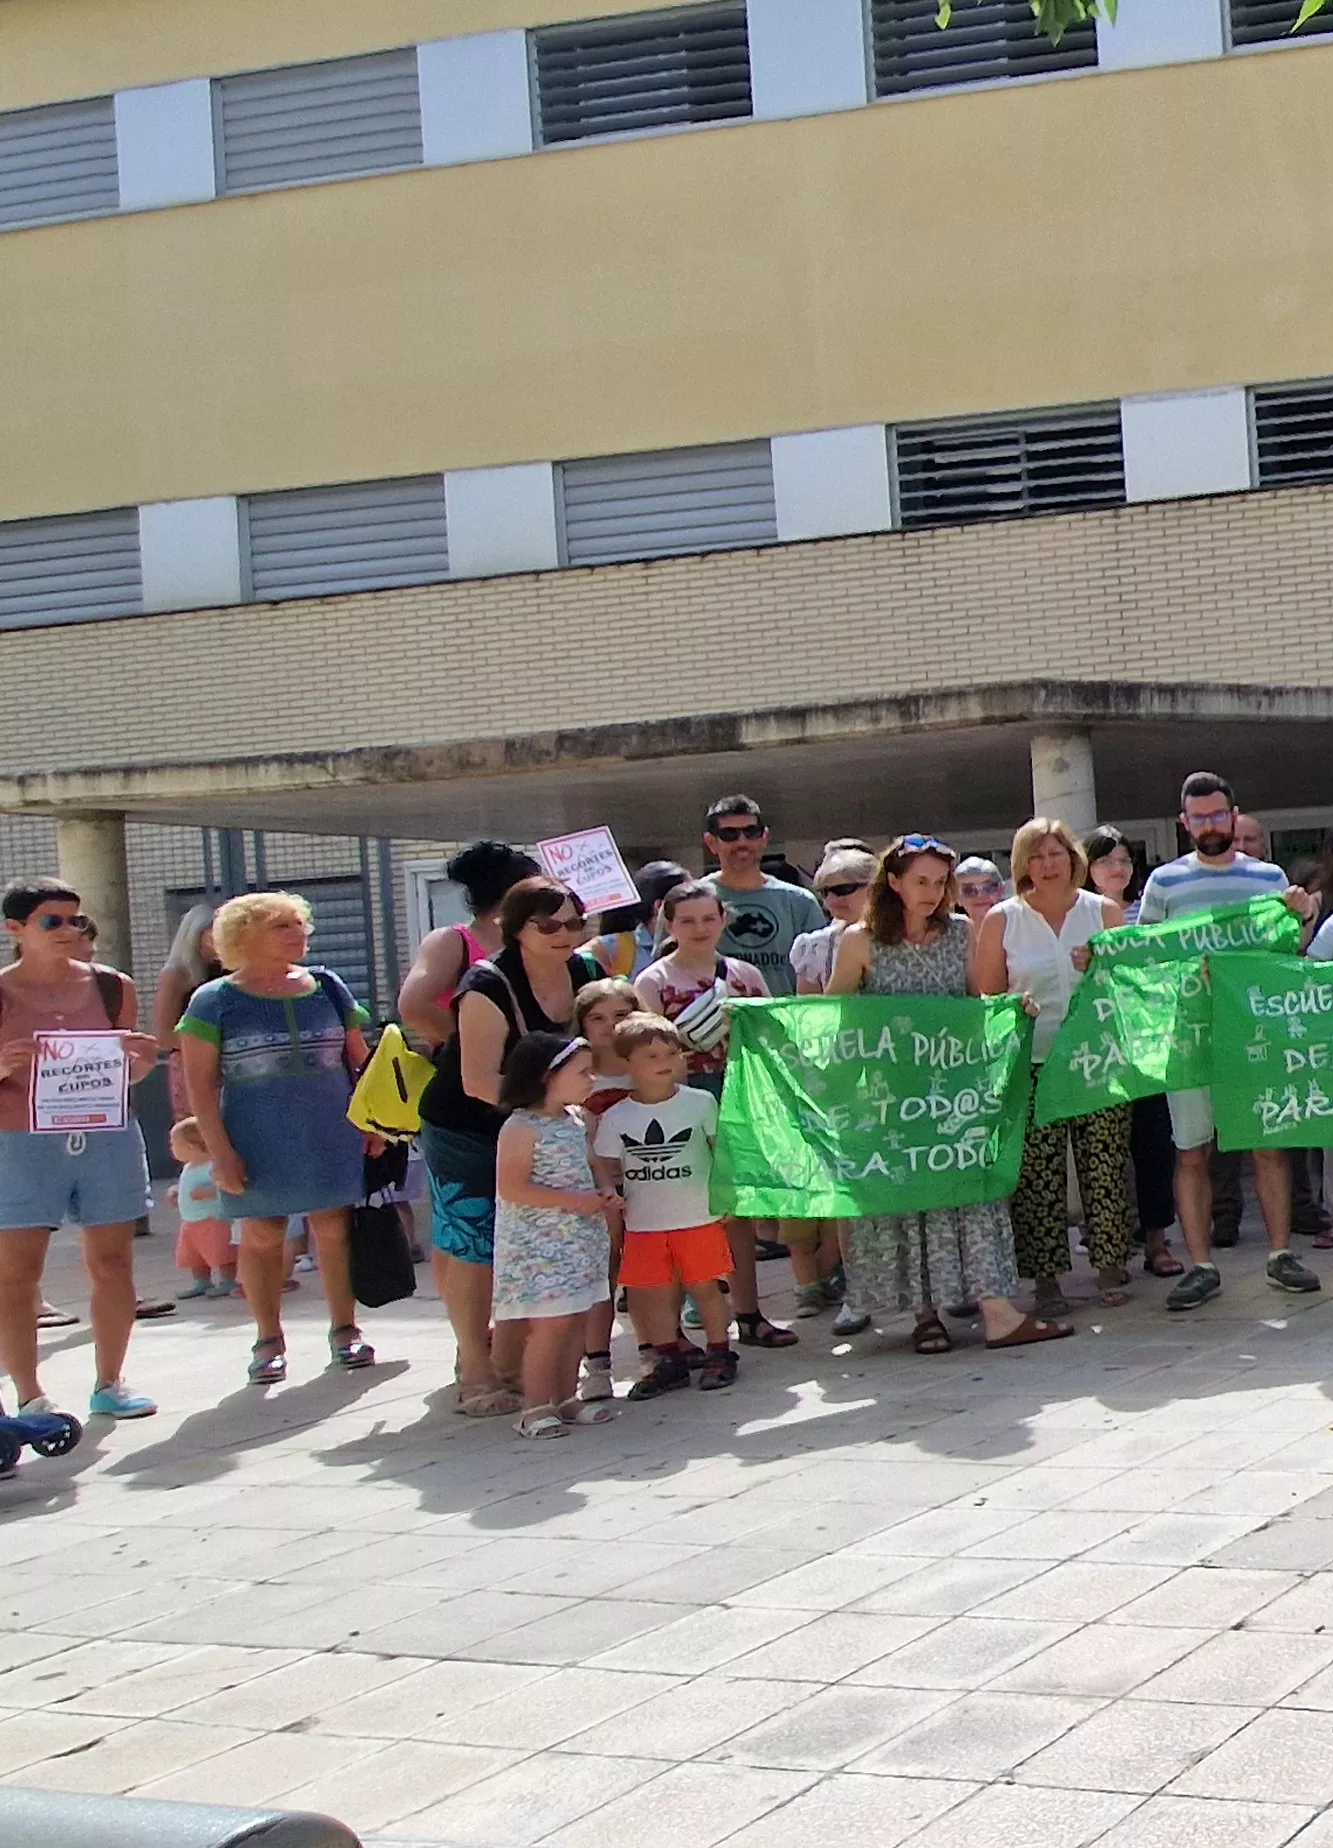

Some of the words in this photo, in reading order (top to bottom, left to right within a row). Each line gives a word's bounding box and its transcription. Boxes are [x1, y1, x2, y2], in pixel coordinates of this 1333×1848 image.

[549, 844, 573, 864] NO
[557, 849, 613, 877] RECORTES
[43, 1040, 75, 1062] NO
[911, 1027, 1022, 1071] PÚBLICA
[1283, 1043, 1327, 1074] DE
[41, 1059, 122, 1078] RECORTES
[58, 1077, 112, 1093] CUPOS
[871, 1087, 1002, 1126] TOD@S
[625, 1165, 692, 1181] adidas
